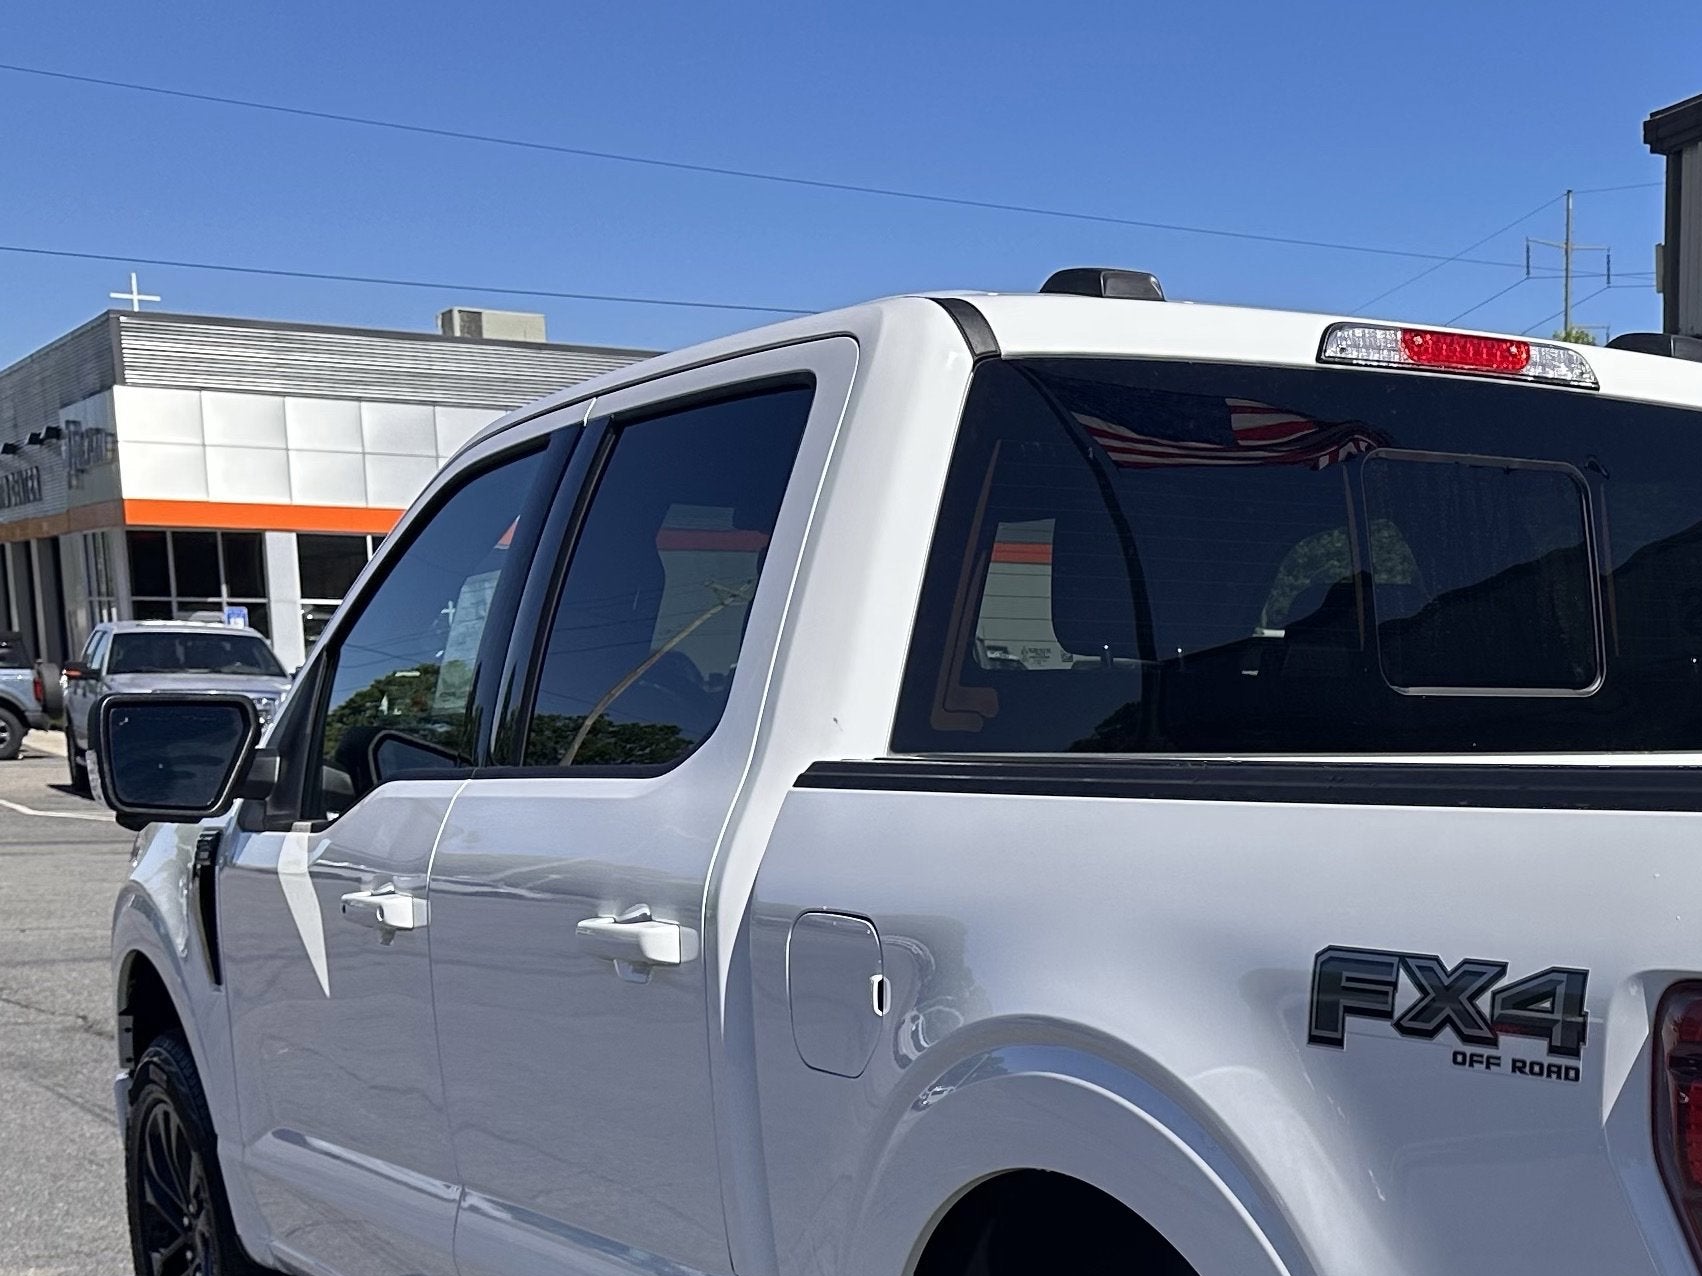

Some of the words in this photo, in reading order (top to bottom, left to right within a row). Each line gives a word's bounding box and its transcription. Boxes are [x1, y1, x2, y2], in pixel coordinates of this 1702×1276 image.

[1307, 945, 1590, 1060] FX4
[1452, 1050, 1501, 1070] OFF
[1510, 1058, 1581, 1082] ROAD
